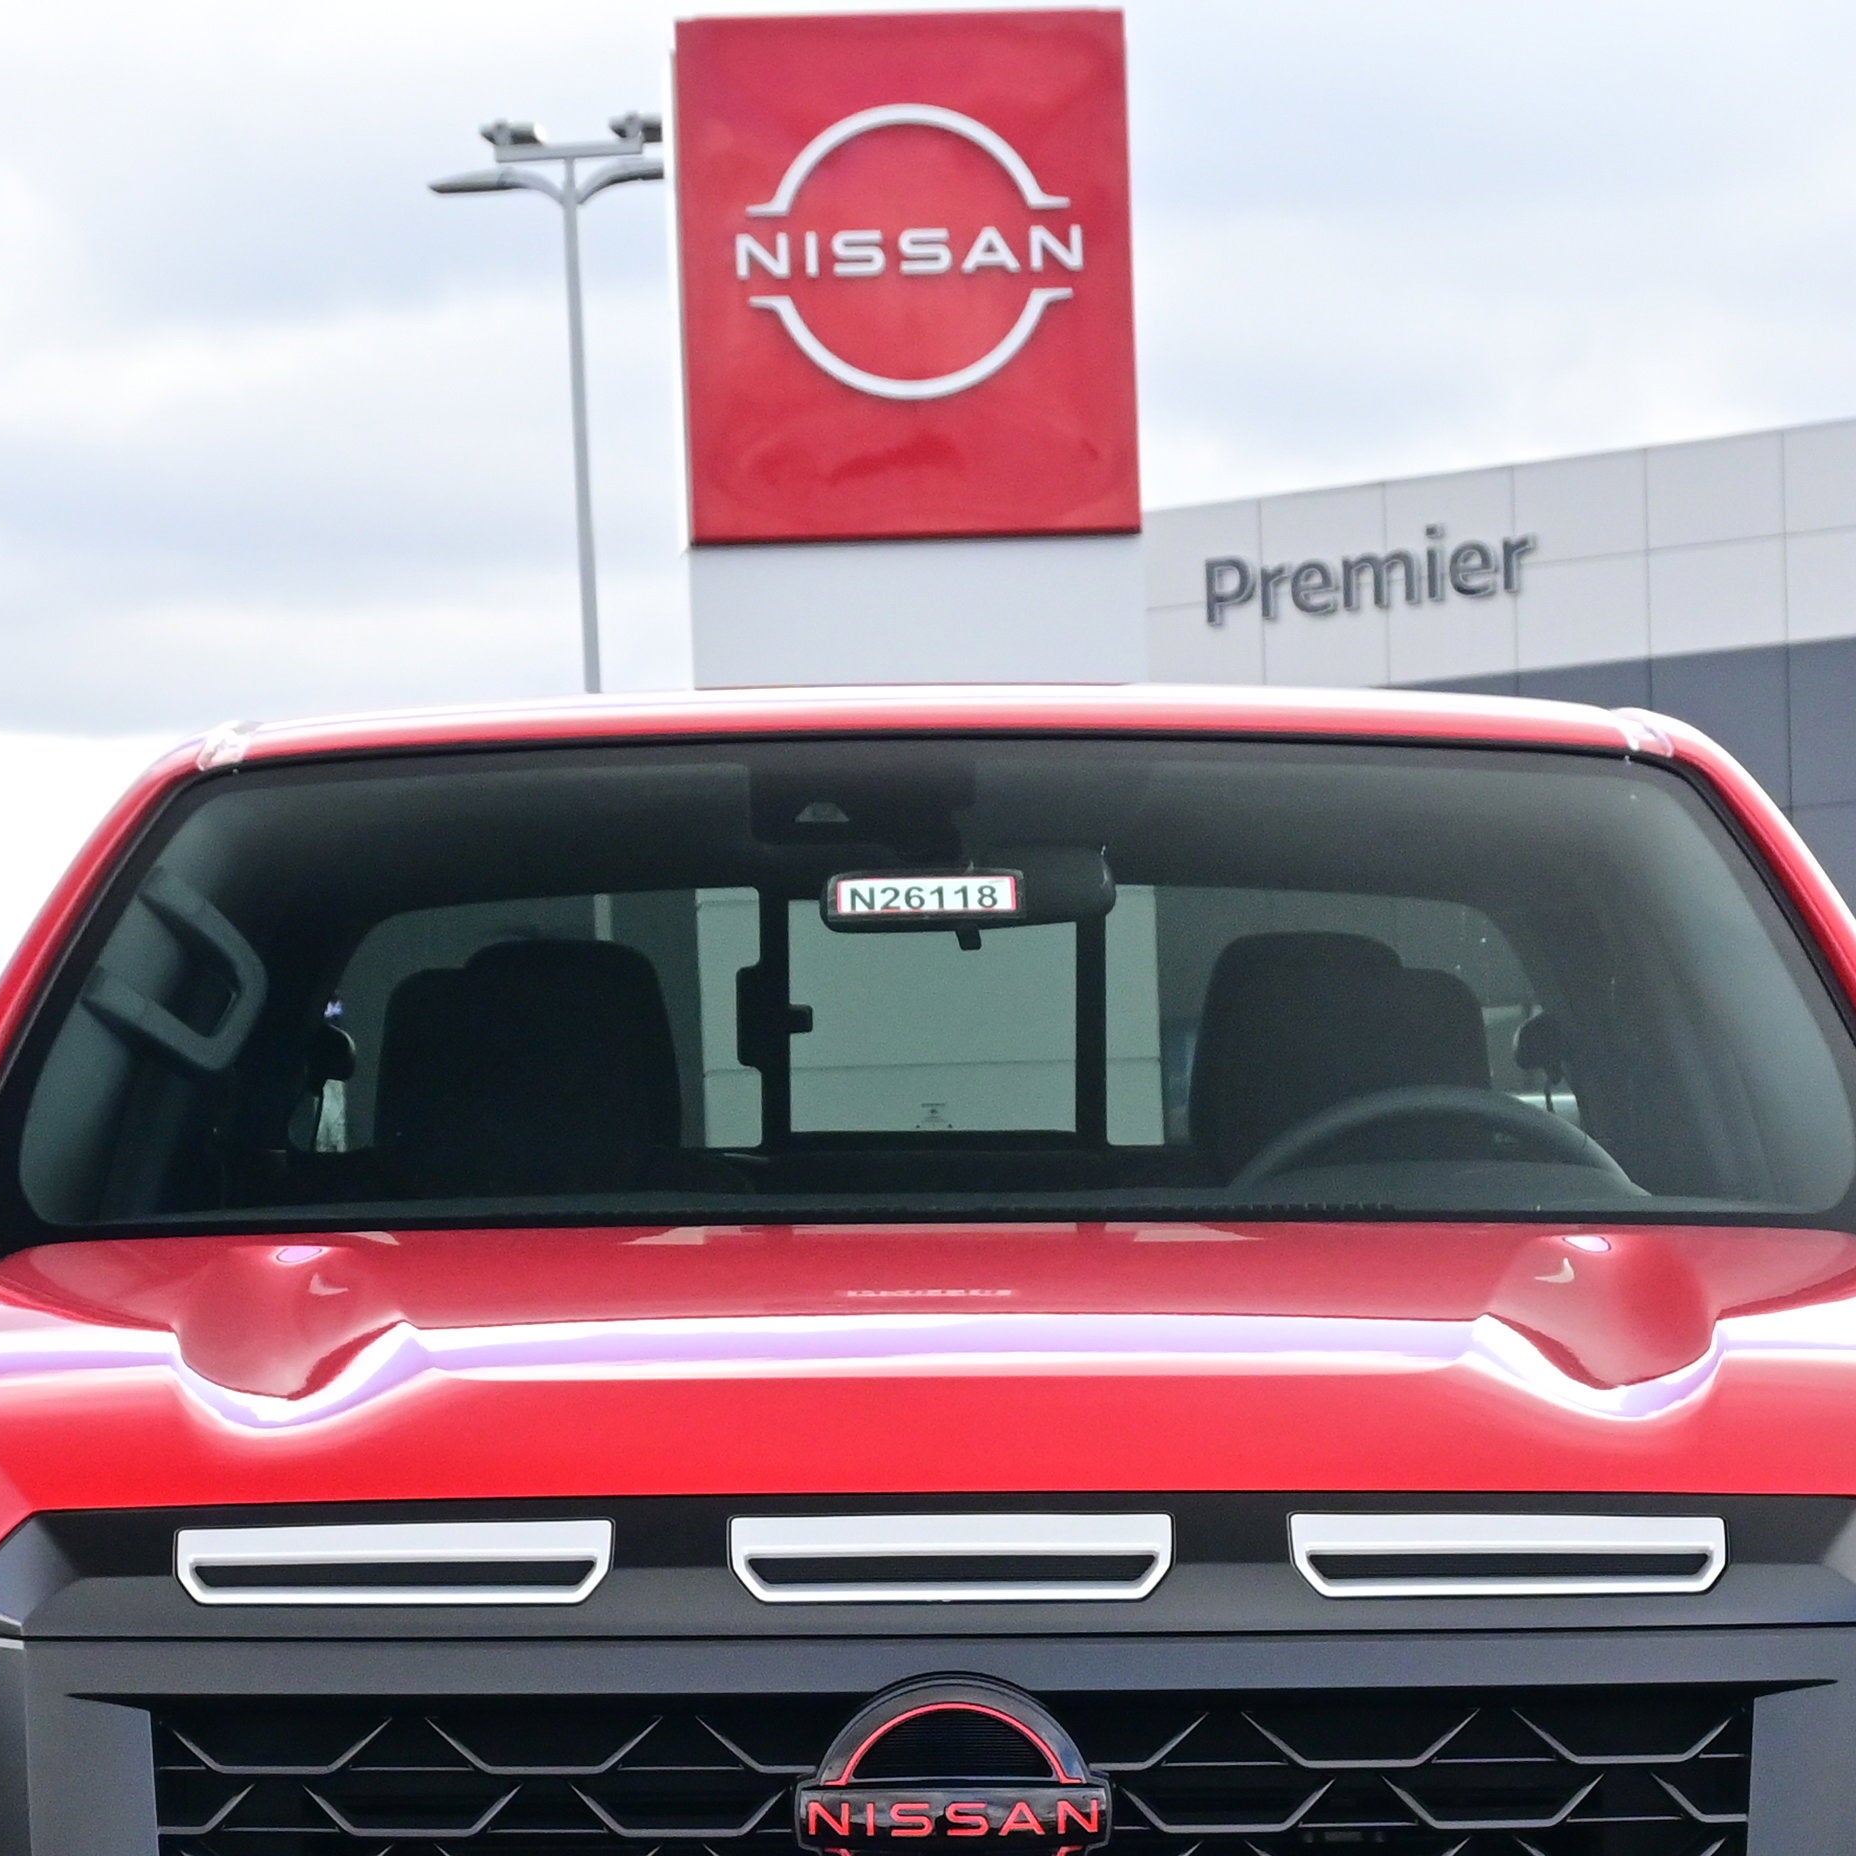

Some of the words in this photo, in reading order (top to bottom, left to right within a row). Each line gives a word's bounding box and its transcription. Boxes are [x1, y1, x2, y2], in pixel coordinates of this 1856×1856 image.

[735, 224, 1084, 280] NISSAN
[1205, 523, 1537, 626] Premier
[849, 885, 999, 912] N26118
[807, 1799, 1100, 1837] NISSAN
